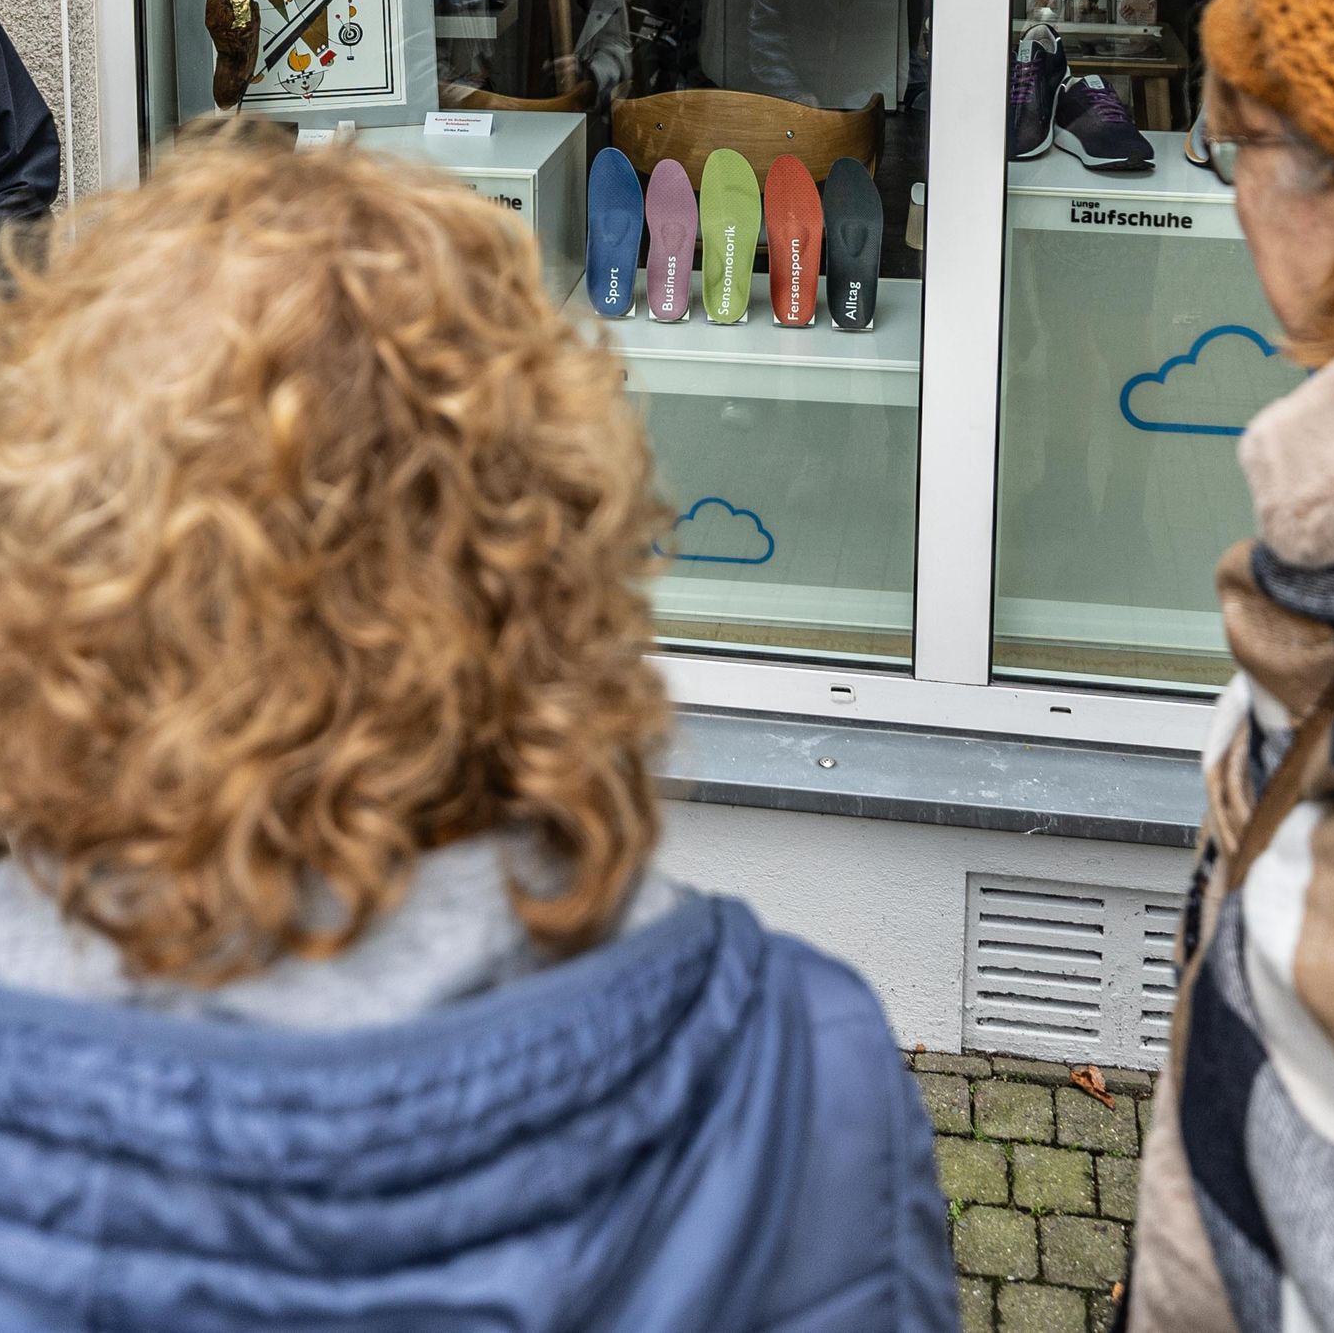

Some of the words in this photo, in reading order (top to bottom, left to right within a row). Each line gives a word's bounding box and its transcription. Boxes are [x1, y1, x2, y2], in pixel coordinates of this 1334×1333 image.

[1070, 208, 1193, 229] Laufschuhe
[1071, 200, 1100, 210] Lunge
[605, 267, 619, 305] Sport
[662, 255, 676, 312] Business
[718, 225, 736, 316] Sensomotorik
[787, 238, 799, 321] Fersensporn
[846, 281, 861, 321] Alltag
